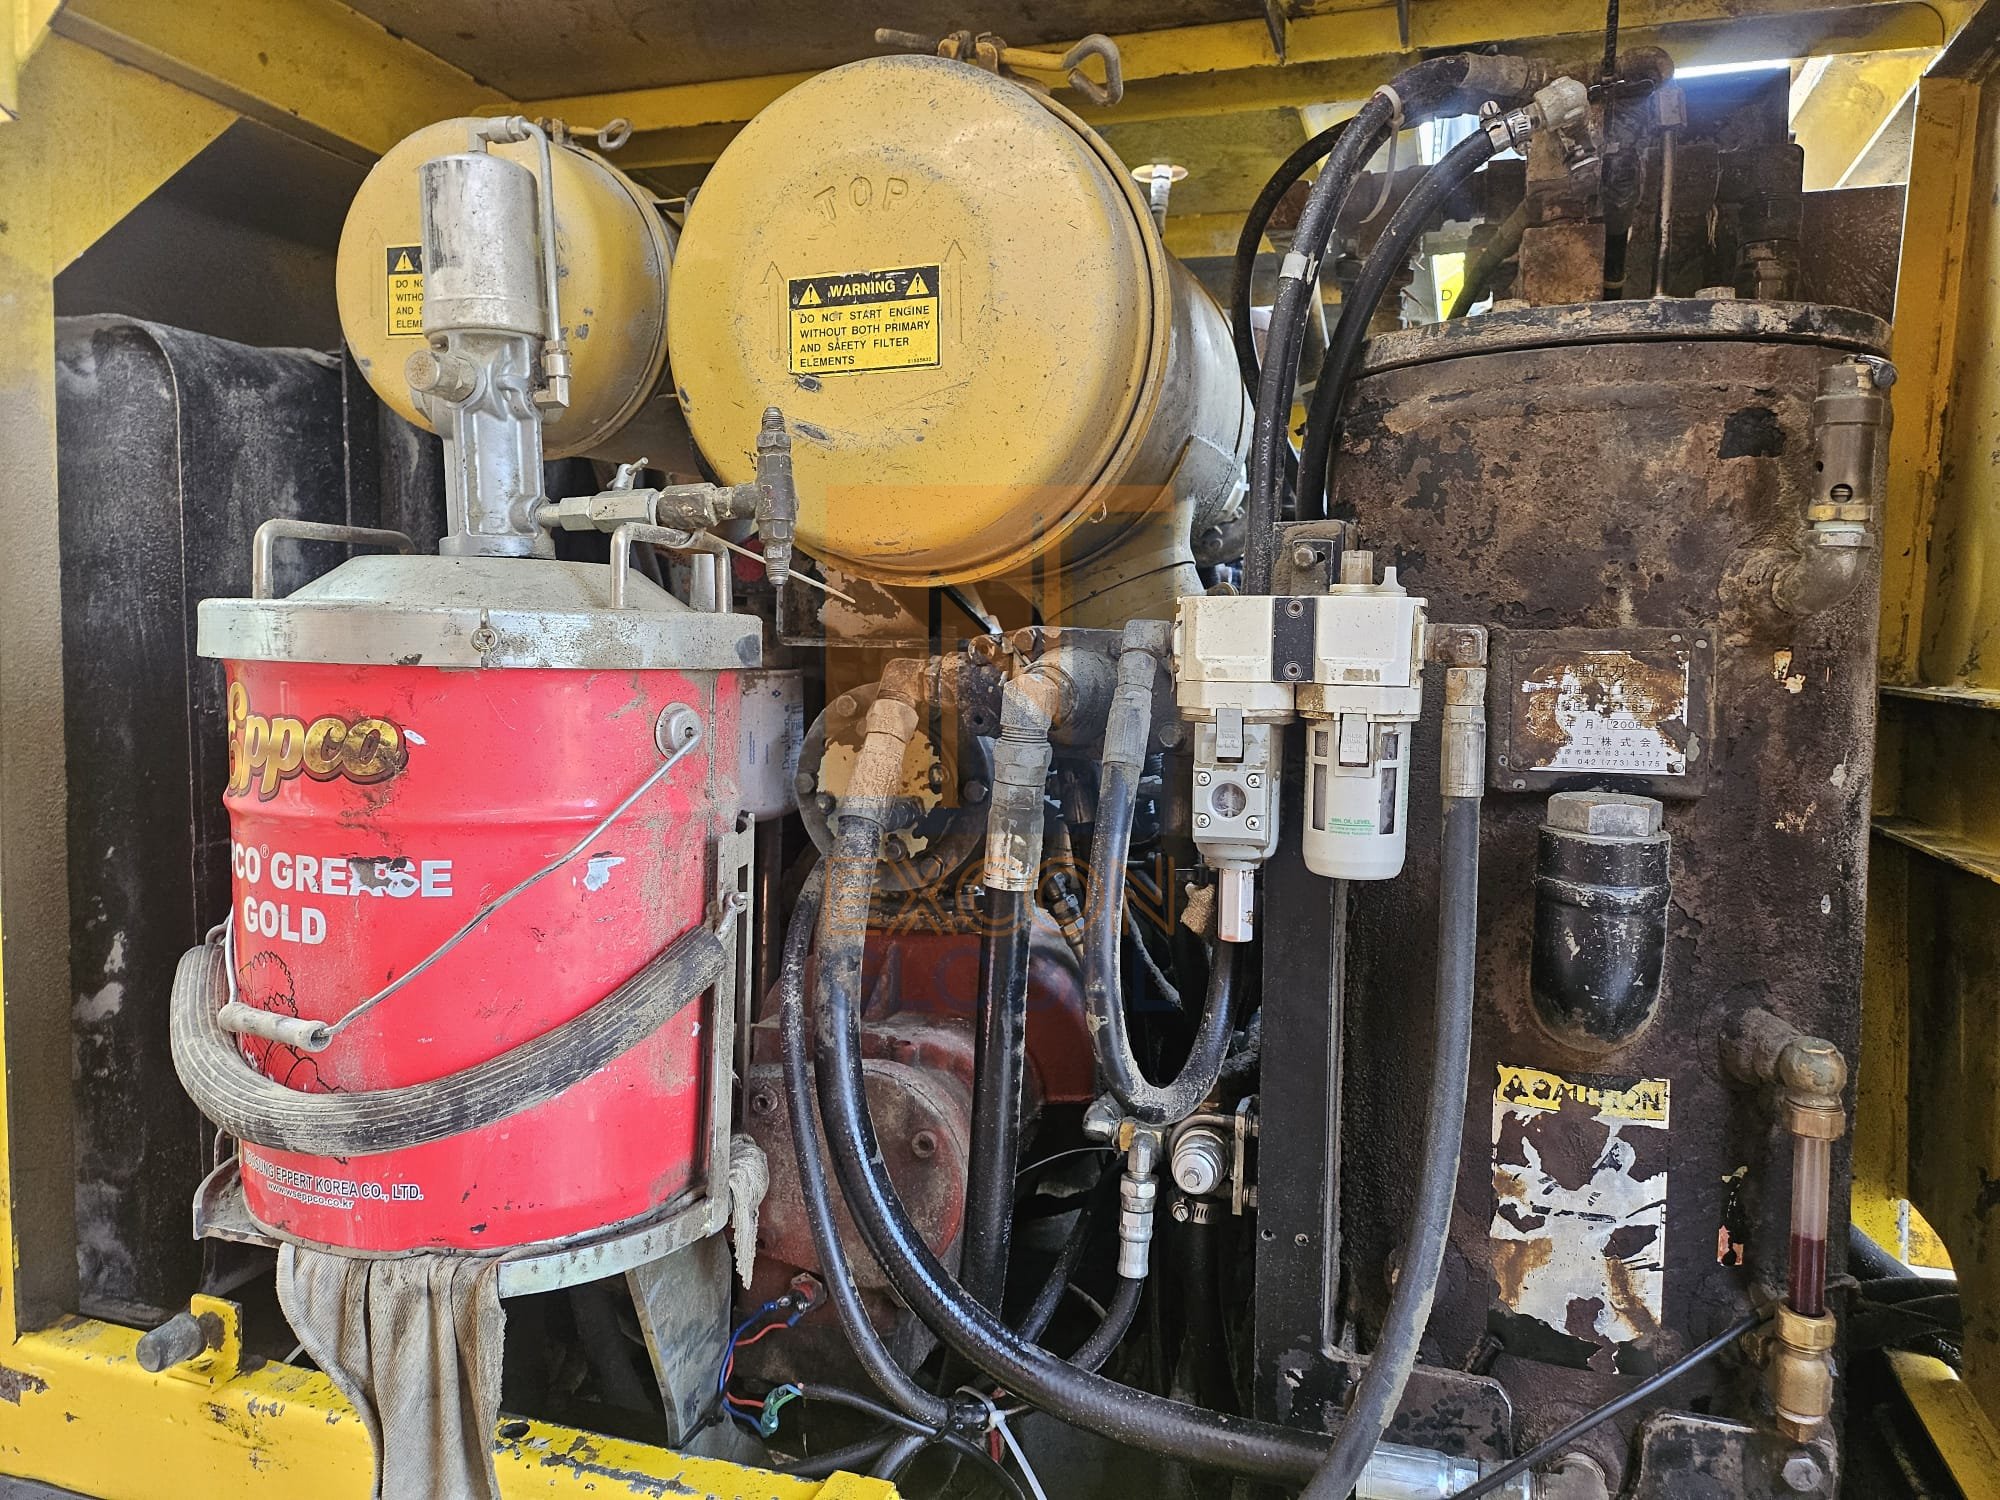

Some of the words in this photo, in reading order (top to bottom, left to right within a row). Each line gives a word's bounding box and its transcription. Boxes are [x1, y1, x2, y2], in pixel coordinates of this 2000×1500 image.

[813, 176, 908, 221] TOP
[396, 280, 408, 288] DO
[829, 279, 896, 298] WARNING
[396, 294, 424, 302] WITHO
[396, 307, 414, 315] AND
[800, 314, 815, 324] DO
[822, 312, 843, 322] NOT
[850, 309, 882, 321] START
[889, 305, 930, 317] ENGINE
[800, 327, 847, 339] WITHOUT
[852, 325, 880, 335] BOTH
[885, 320, 930, 332] PRIMARY
[800, 343, 821, 353] AND
[827, 340, 867, 351] SAFETY
[874, 337, 909, 348] FILTER
[800, 355, 855, 368] ELEMENTS
[243, 896, 327, 945] GOLD
[276, 1167, 314, 1190] EPPERT
[315, 1176, 359, 1198] KOREA
[361, 1183, 389, 1203] CO.,
[392, 1184, 424, 1200] LTD.
